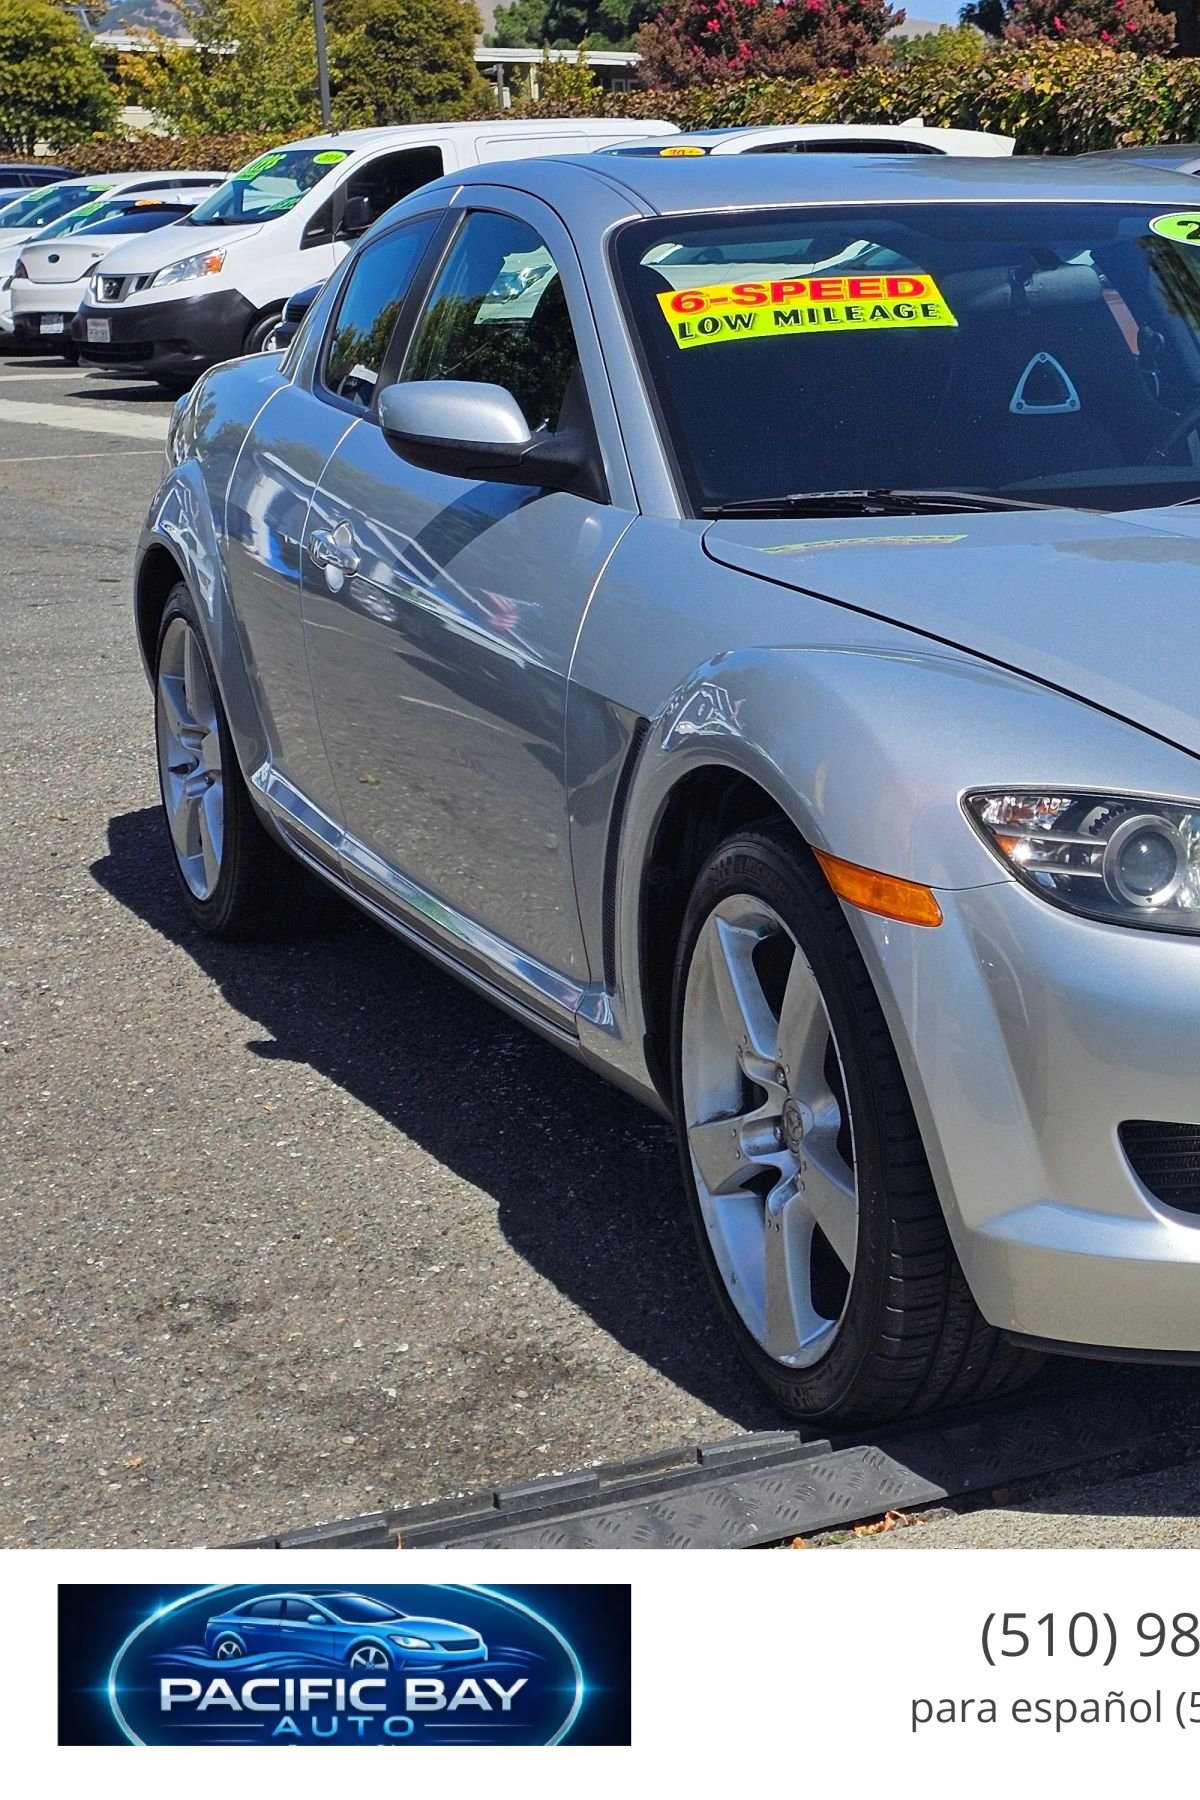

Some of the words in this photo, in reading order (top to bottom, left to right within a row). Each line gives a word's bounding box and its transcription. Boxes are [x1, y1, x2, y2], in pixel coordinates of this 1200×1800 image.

[670, 277, 929, 314] 6-SPEED
[678, 312, 755, 340] LOW
[773, 303, 940, 326] MILEAGE
